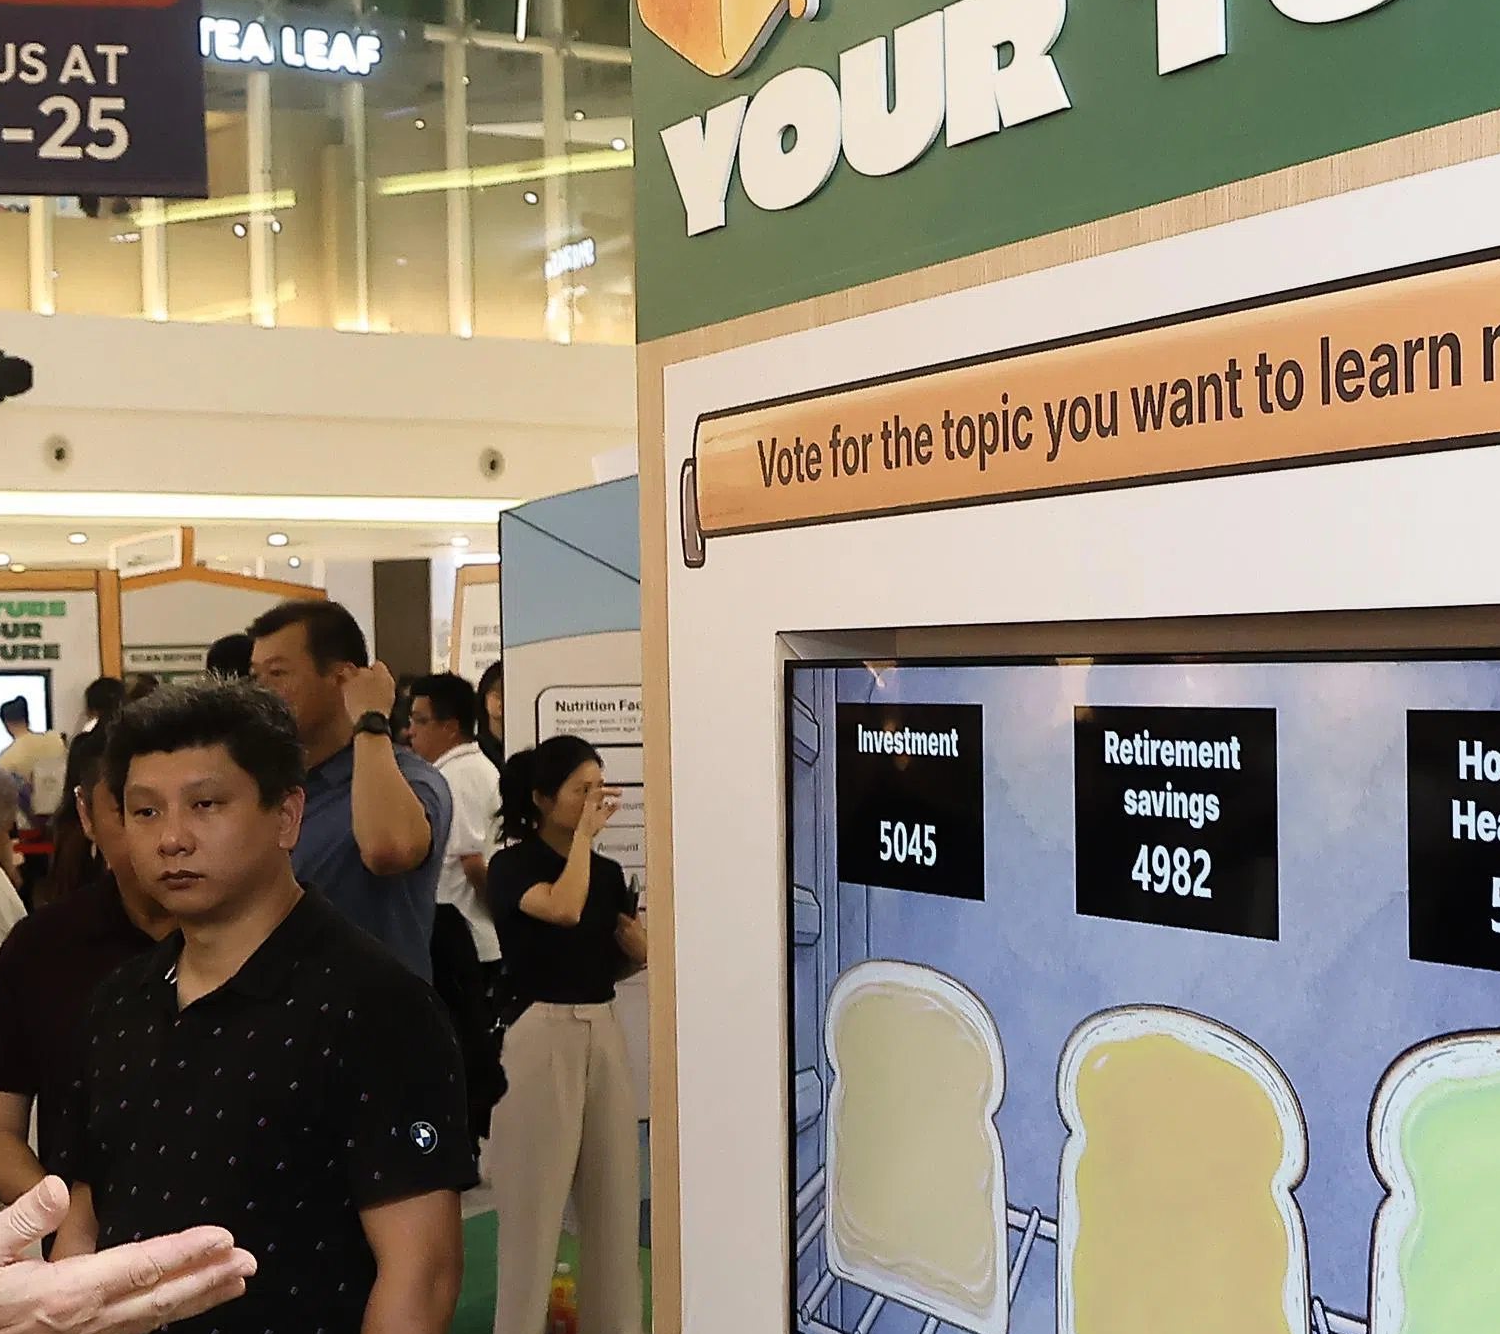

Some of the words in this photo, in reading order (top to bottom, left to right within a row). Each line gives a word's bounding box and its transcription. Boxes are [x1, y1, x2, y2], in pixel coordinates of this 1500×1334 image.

[59, 43, 129, 86] AT
[200, 16, 275, 65] TEA
[280, 25, 383, 76] LEAF
[757, 436, 822, 488] Vote
[828, 424, 873, 478] for
[880, 414, 934, 470] the
[941, 392, 1034, 472] topic
[1043, 390, 1118, 463] you
[1129, 358, 1244, 433] want
[1254, 352, 1304, 414] to
[1320, 332, 1462, 406] learn
[556, 700, 616, 712] Nutrition
[619, 699, 642, 711] Fac
[857, 723, 959, 758] Investment
[1104, 729, 1241, 770] Retirement
[1123, 781, 1220, 829] savings
[879, 820, 937, 867] 5045
[1131, 844, 1212, 899] 4982
